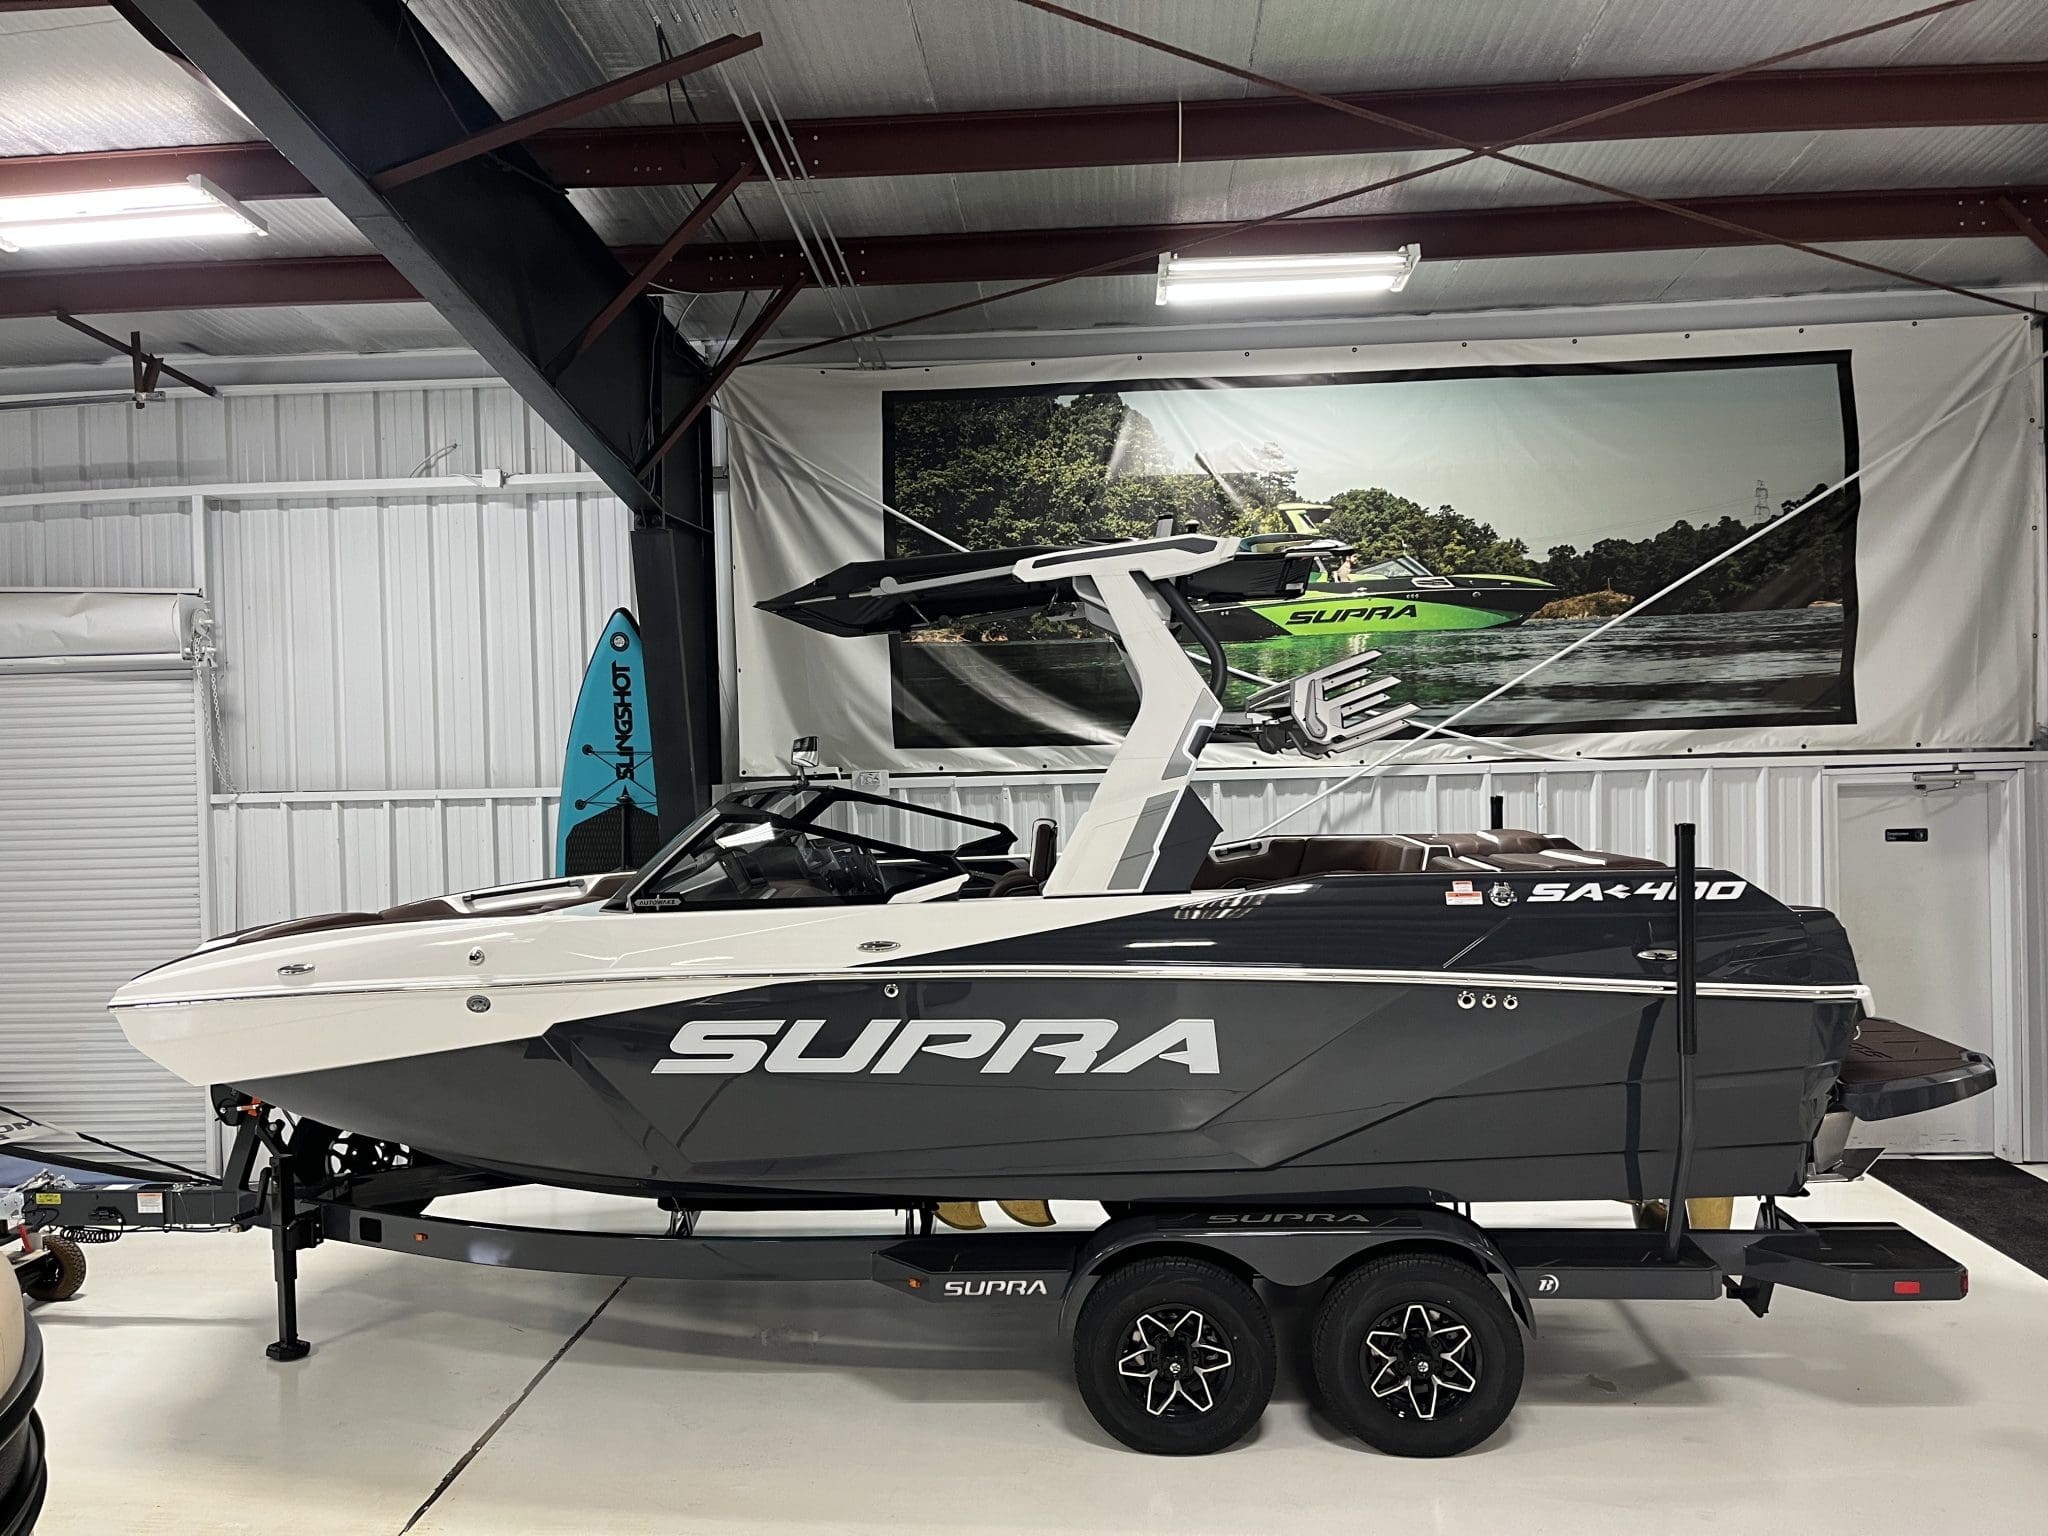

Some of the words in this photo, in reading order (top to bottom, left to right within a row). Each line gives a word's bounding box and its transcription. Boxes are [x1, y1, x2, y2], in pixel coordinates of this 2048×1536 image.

[1285, 604, 1417, 625] SUPRA
[611, 659, 635, 781] SLINGSHOT
[651, 1018, 1220, 1075] SUPRA
[1207, 1213, 1370, 1224] SUPRA
[943, 1279, 1048, 1296] SUPRA
